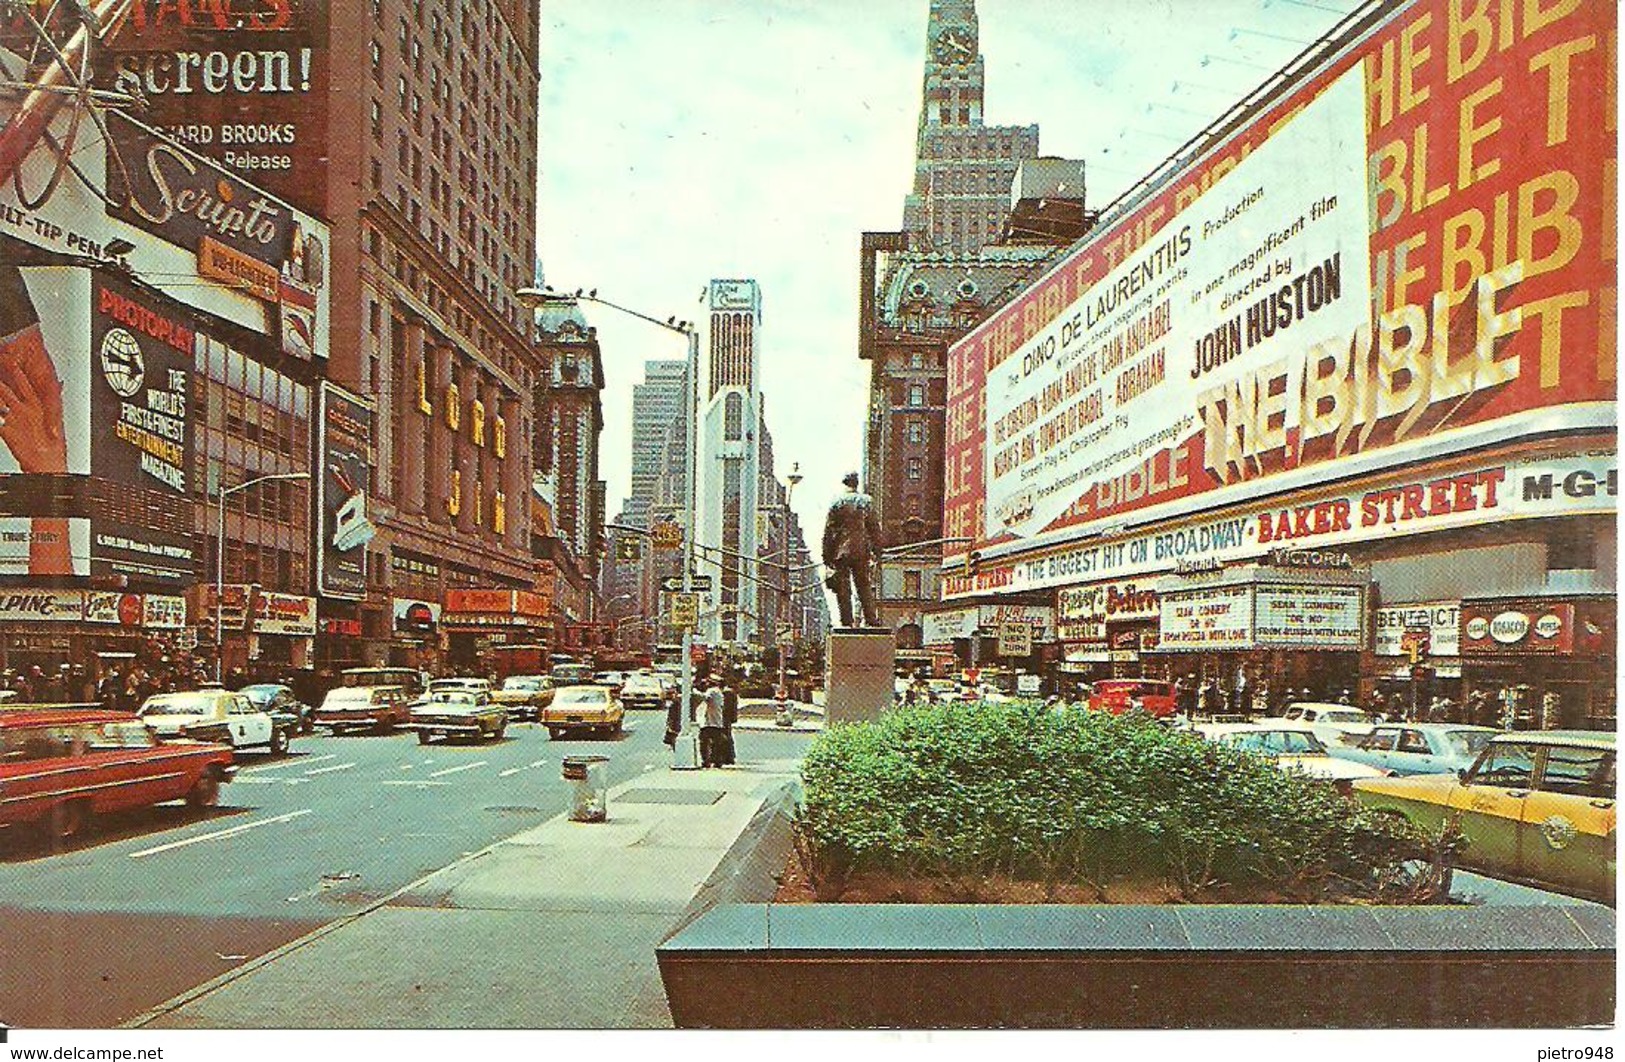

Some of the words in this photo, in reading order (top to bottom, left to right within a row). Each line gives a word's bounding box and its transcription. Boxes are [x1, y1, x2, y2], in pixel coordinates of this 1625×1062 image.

[114, 47, 312, 93] screen!
[222, 124, 295, 144] BROOKS
[225, 152, 291, 169] Release
[132, 144, 276, 244] Scripto
[1157, 267, 1188, 296] events
[1191, 289, 1202, 305] in
[1205, 277, 1225, 294] one
[1228, 214, 1305, 278] magnificent
[1310, 195, 1338, 222] film
[1023, 335, 1056, 377] DINO
[1061, 312, 1082, 348] DE
[1086, 225, 1192, 330] LAURENTIIS
[1203, 186, 1264, 239] Production
[1220, 267, 1271, 312] directed
[1275, 256, 1292, 278] by
[1191, 314, 1242, 379] JOHN
[1246, 251, 1342, 349] HUSTON
[1115, 346, 1165, 407] ABRAHAM
[1197, 355, 1291, 484] THE
[1298, 260, 1526, 442] BIBLE
[1025, 559, 1046, 582] THE
[1048, 550, 1098, 577] BIGGEST
[1103, 541, 1125, 568] HIT
[1129, 534, 1148, 562] ON
[1153, 516, 1248, 560] BROADWAY
[1257, 498, 1351, 544] BAKER
[1360, 466, 1506, 529] STREET
[1272, 549, 1352, 567] VICTORIA
[0, 594, 60, 616] PINE
[1007, 625, 1025, 634] NO
[1376, 609, 1458, 628] BENEDICT
